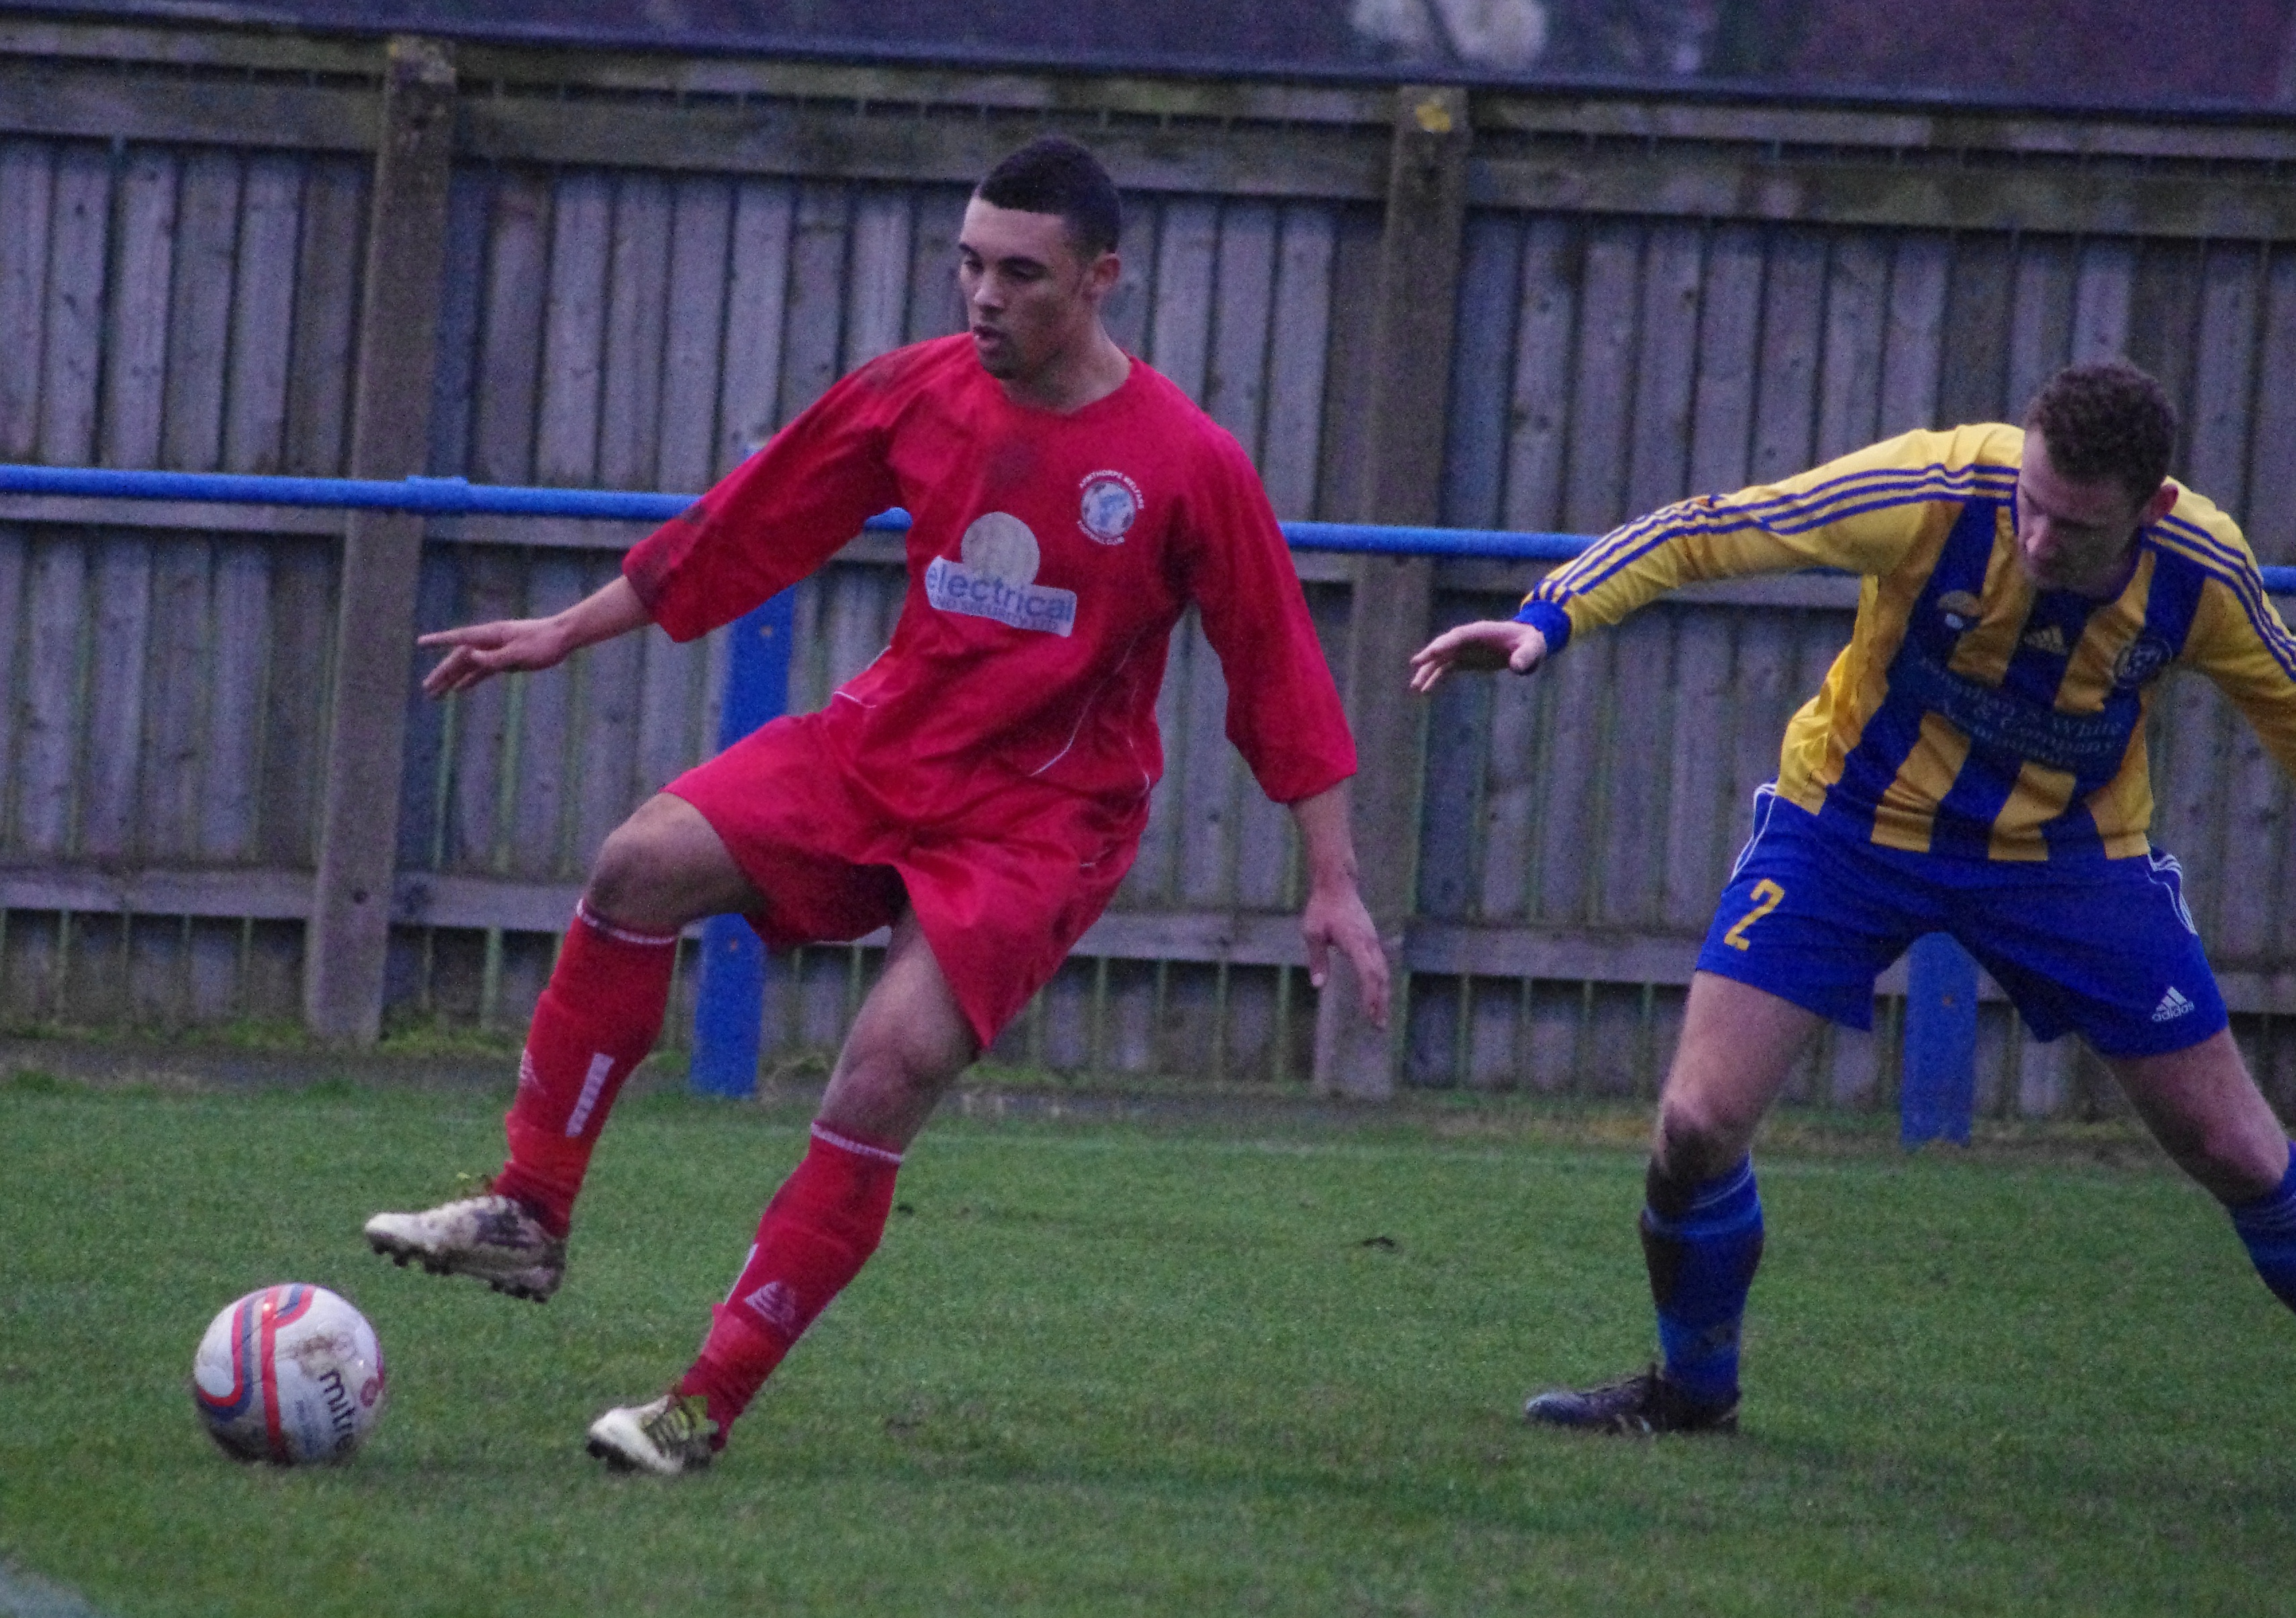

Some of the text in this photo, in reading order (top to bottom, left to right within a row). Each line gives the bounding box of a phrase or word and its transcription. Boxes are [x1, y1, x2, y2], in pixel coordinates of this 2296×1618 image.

[927, 564, 1072, 622] electrical
[1724, 878, 1785, 951] 2
[2152, 1001, 2195, 1022] adidas
[320, 1369, 355, 1451] mitre
